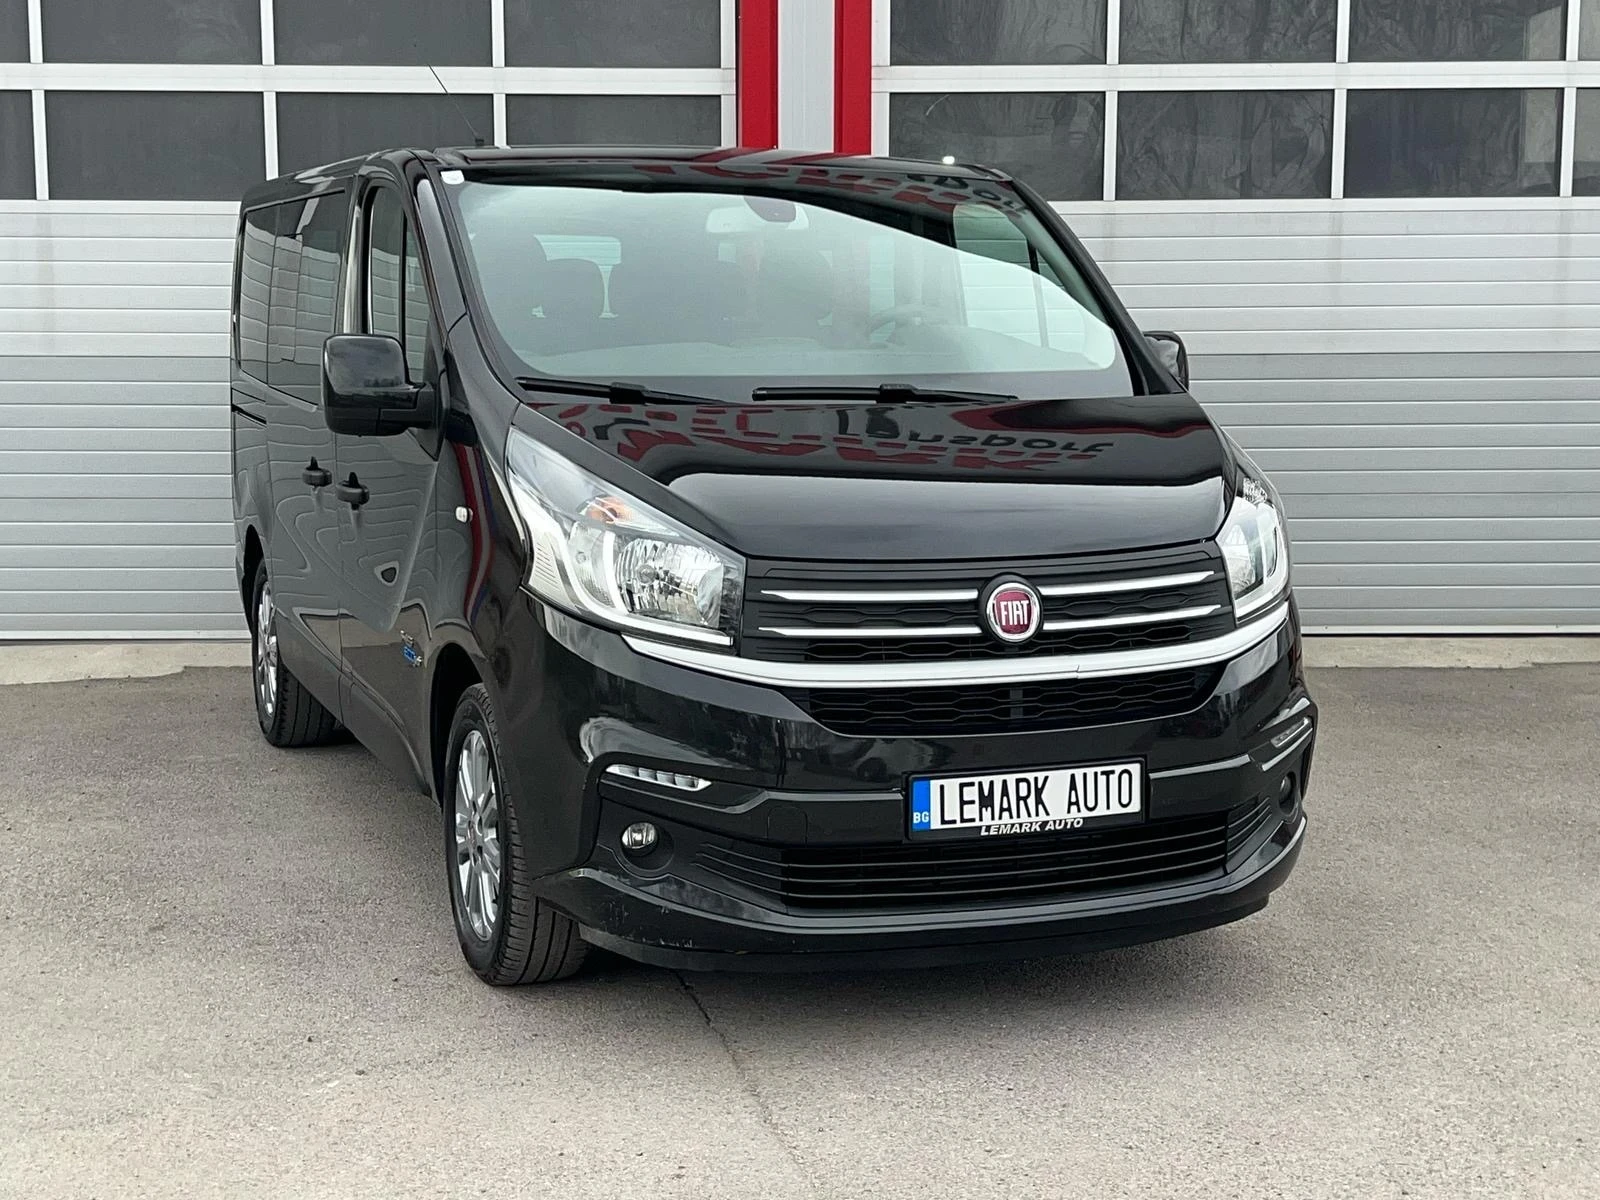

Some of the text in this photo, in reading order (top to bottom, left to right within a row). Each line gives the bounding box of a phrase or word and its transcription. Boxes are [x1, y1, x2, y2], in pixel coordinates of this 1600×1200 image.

[1000, 600, 1030, 626] FIAT
[939, 768, 1133, 826] LEMARK AUTO
[912, 811, 930, 825] BG
[980, 817, 1083, 836] LEMARK AUTO
